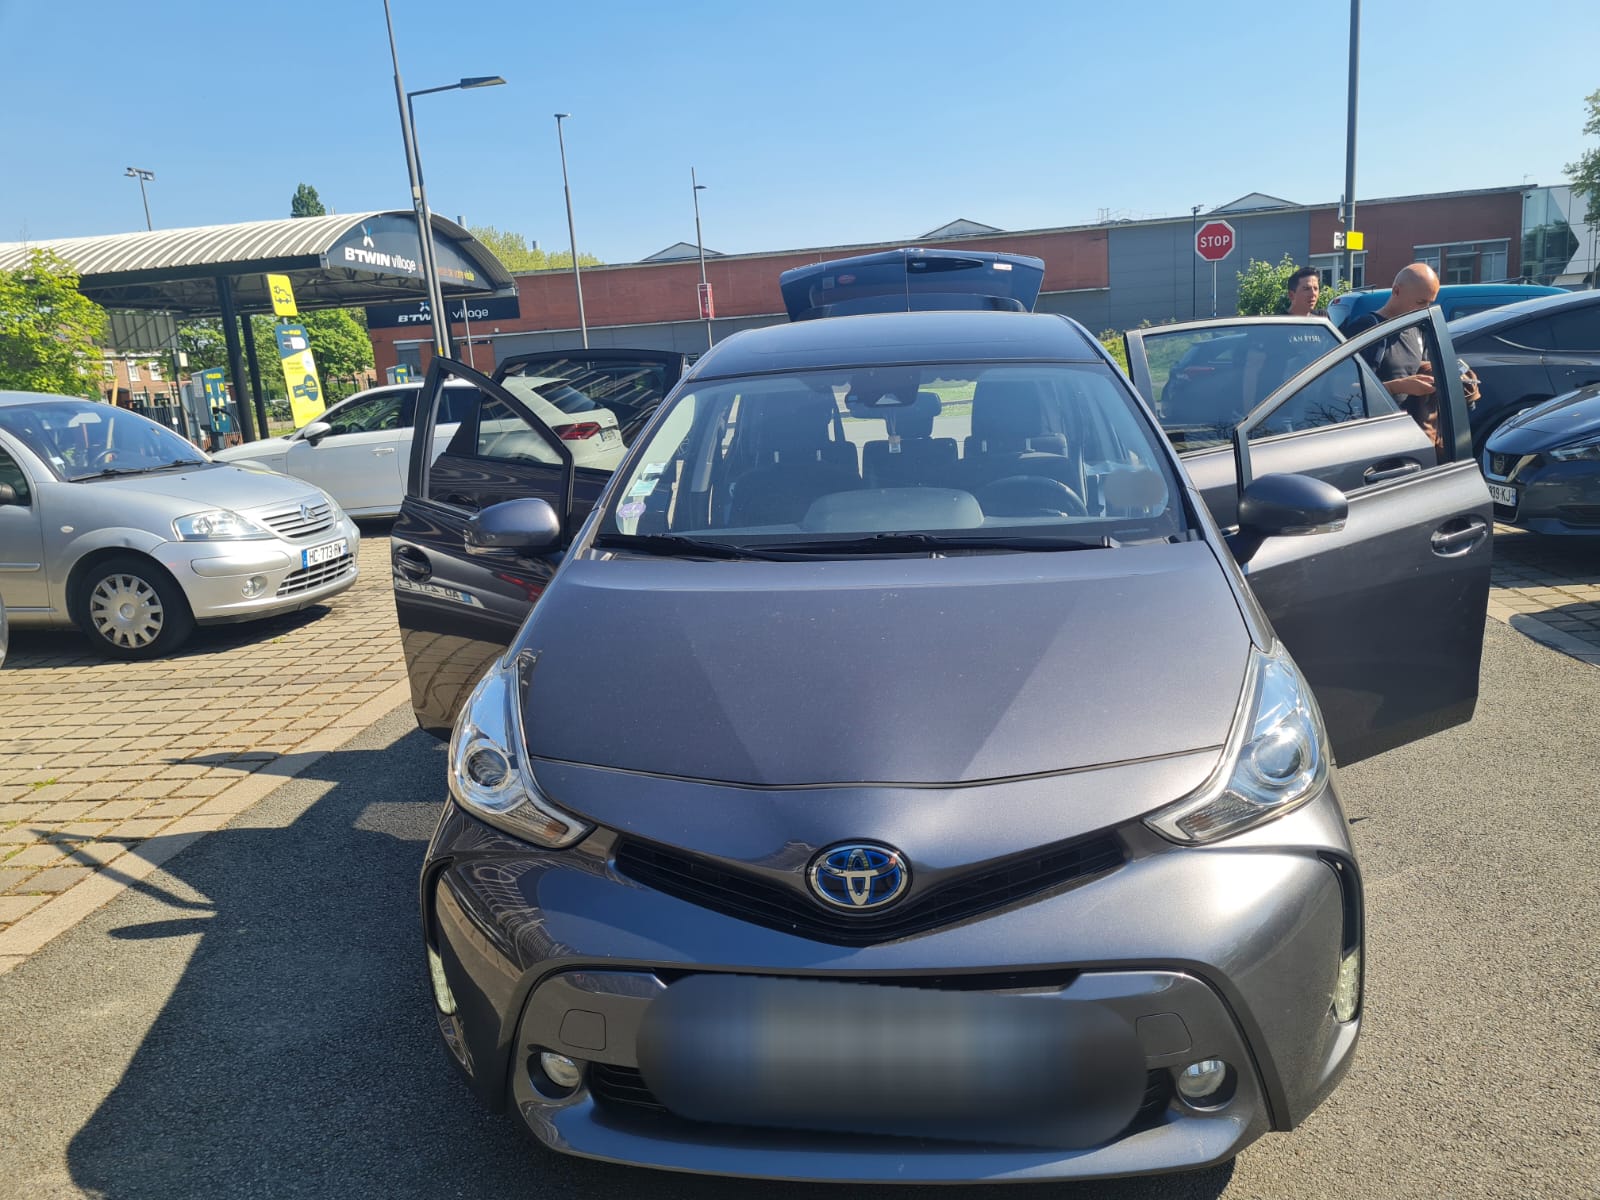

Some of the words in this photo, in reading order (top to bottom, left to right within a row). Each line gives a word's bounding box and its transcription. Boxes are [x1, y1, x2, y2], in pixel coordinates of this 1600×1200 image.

[1200, 235, 1230, 248] STOP
[344, 246, 391, 267] BTWIN
[391, 254, 416, 274] village
